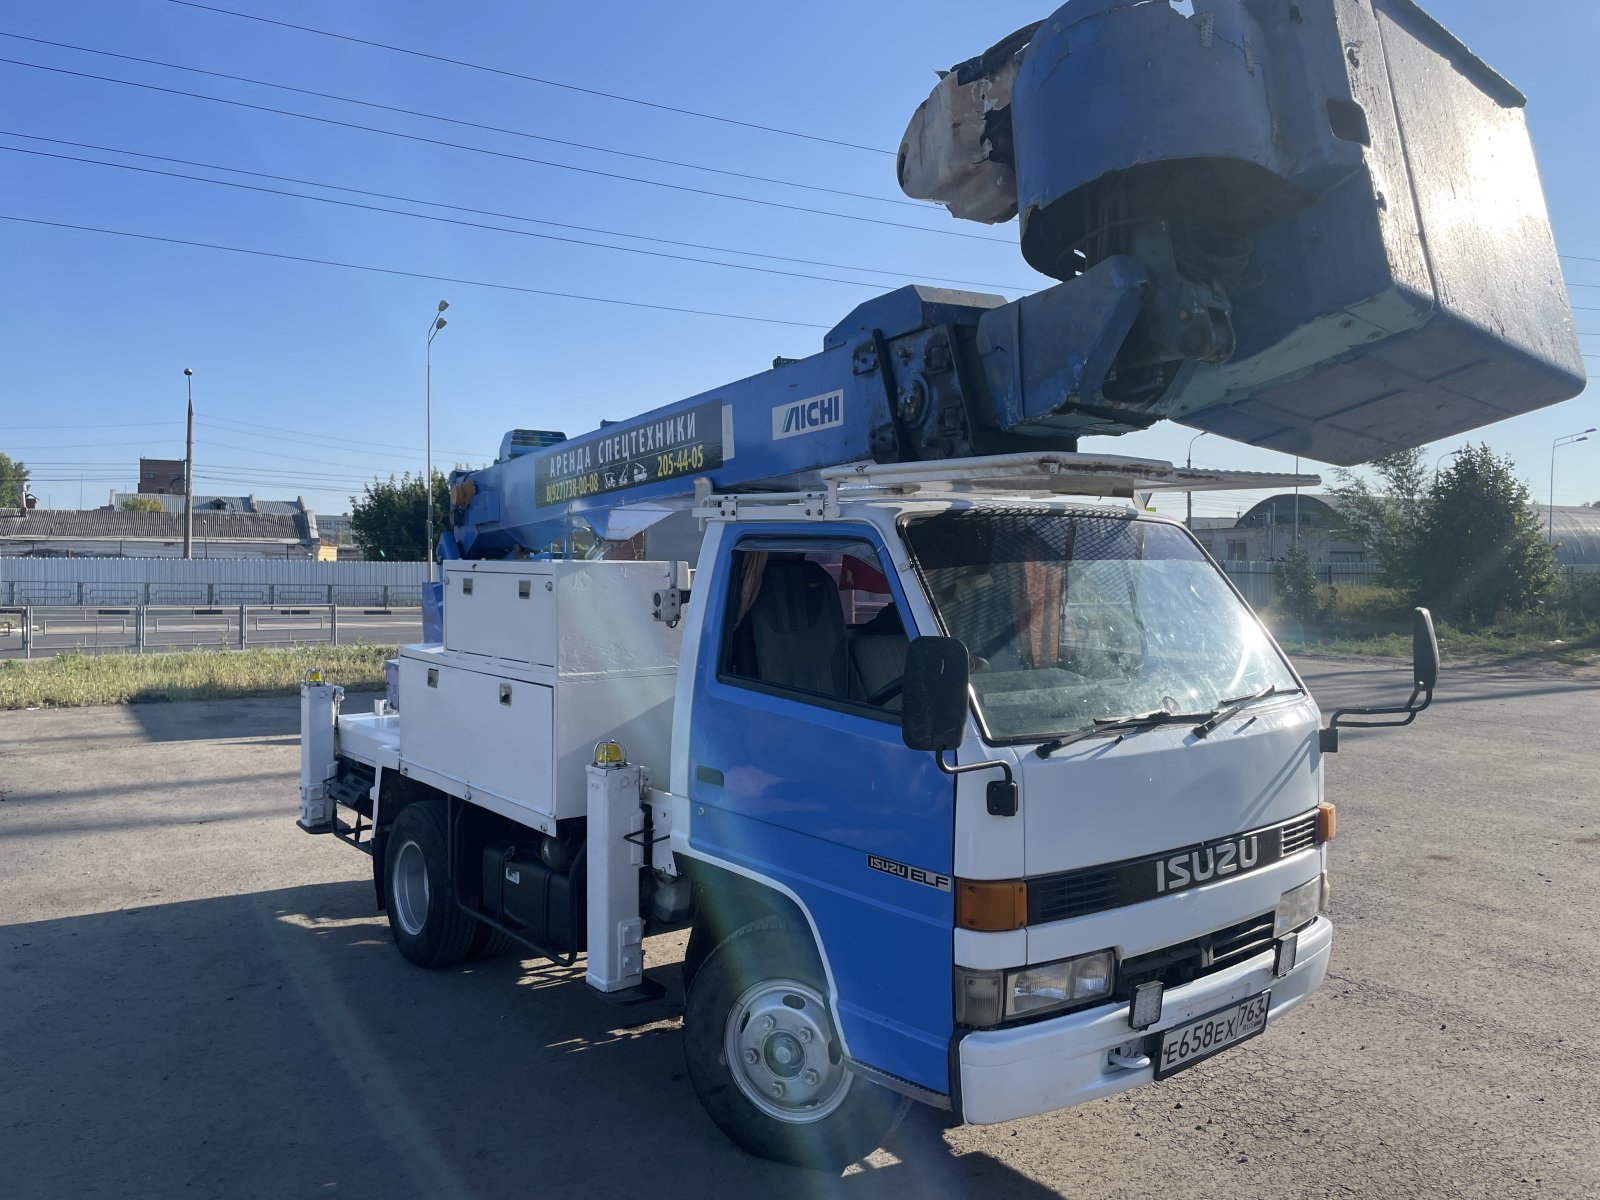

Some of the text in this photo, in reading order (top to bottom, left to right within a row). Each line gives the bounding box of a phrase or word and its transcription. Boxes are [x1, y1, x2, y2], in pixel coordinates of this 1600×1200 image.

[781, 396, 840, 433] AICHI
[550, 412, 696, 477] АРЕНДА СПЕЦТЕХНИКИ
[657, 445, 704, 477] 205-44-05
[870, 857, 949, 888] ISUZU ELF
[1156, 836, 1258, 893] ISUZU
